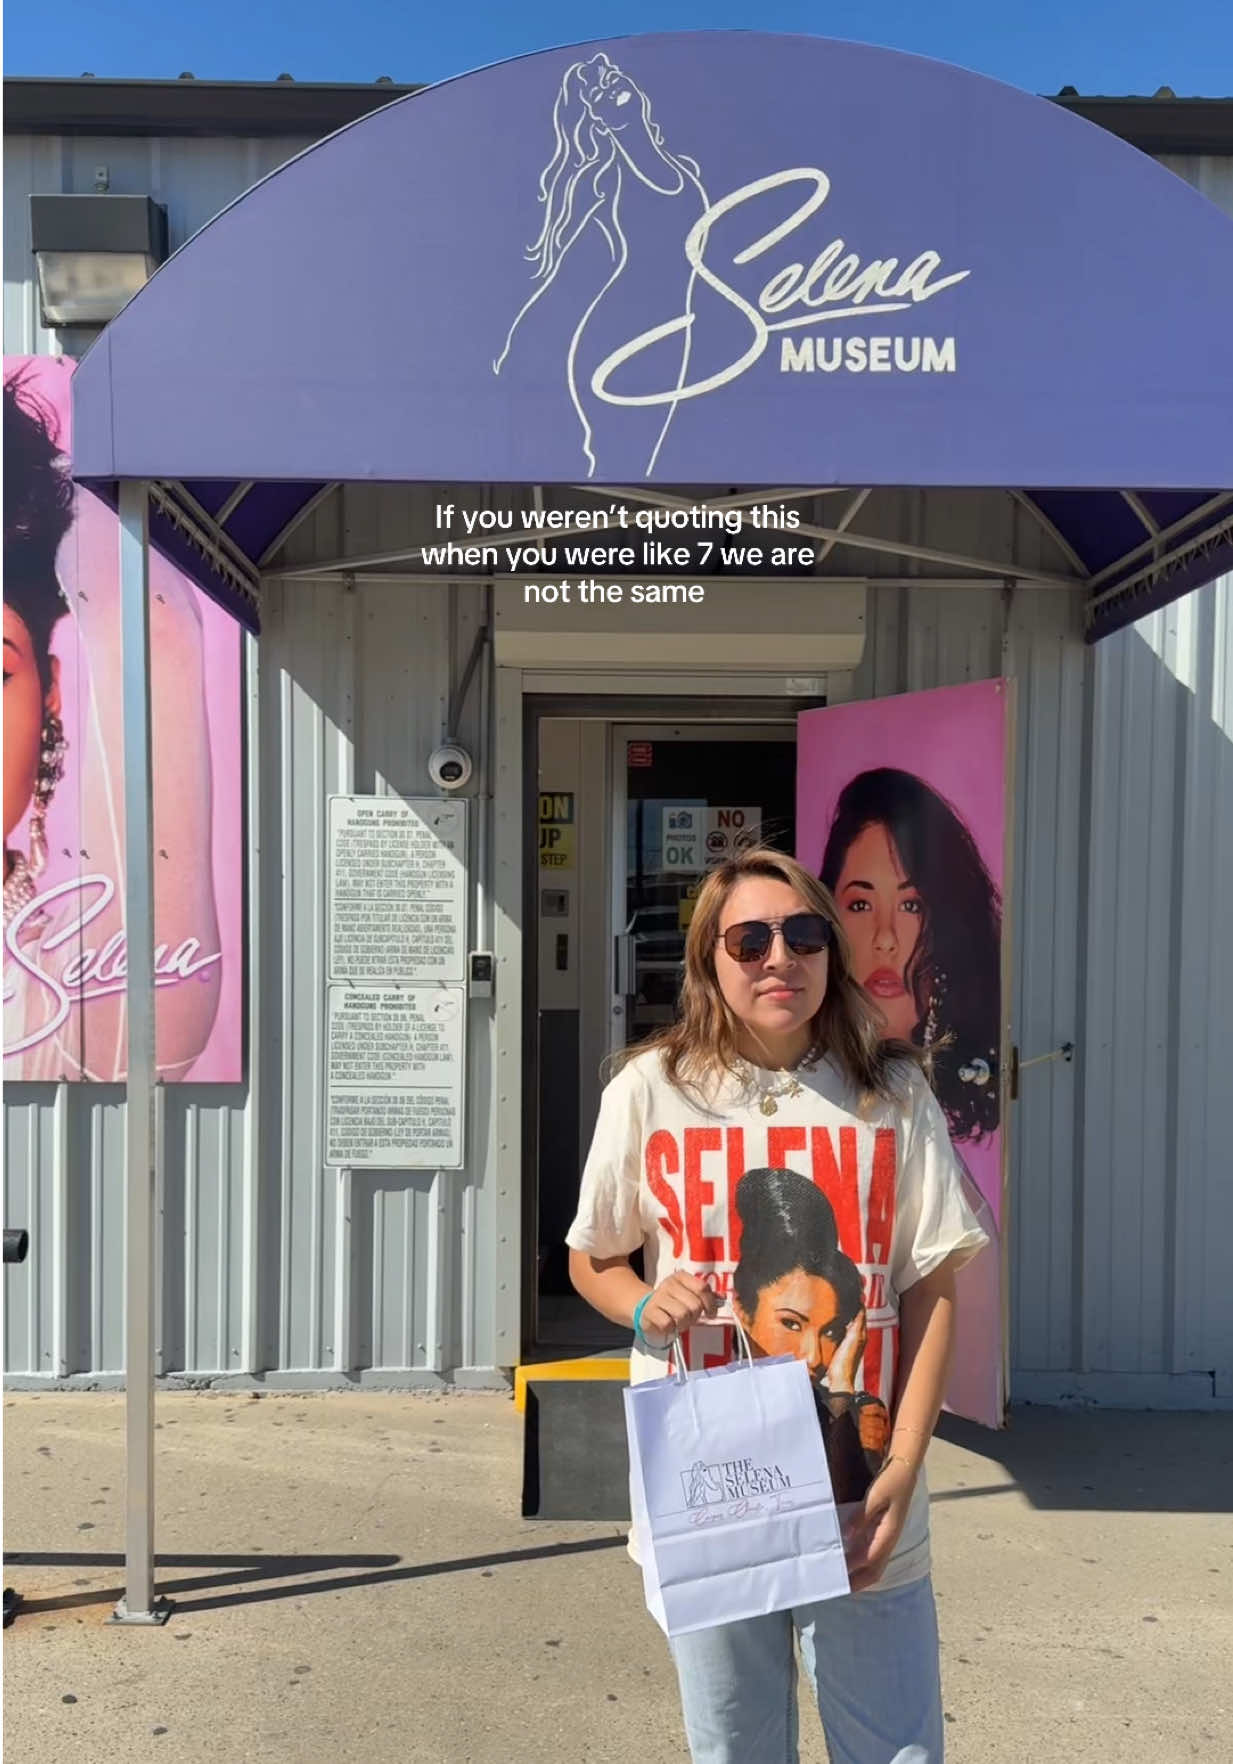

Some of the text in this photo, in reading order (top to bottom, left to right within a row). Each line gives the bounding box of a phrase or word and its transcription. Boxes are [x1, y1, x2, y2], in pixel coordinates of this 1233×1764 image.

[591, 167, 971, 406] Selena
[780, 337, 956, 372] MUSEUM
[718, 810, 745, 828] NO
[666, 834, 696, 842] PHOTOS
[666, 847, 693, 864] OK
[645, 1126, 897, 1264] SELNA
[722, 1458, 753, 1476] THE
[725, 1465, 783, 1488] SELENA
[728, 1475, 792, 1499] MUSEUM
